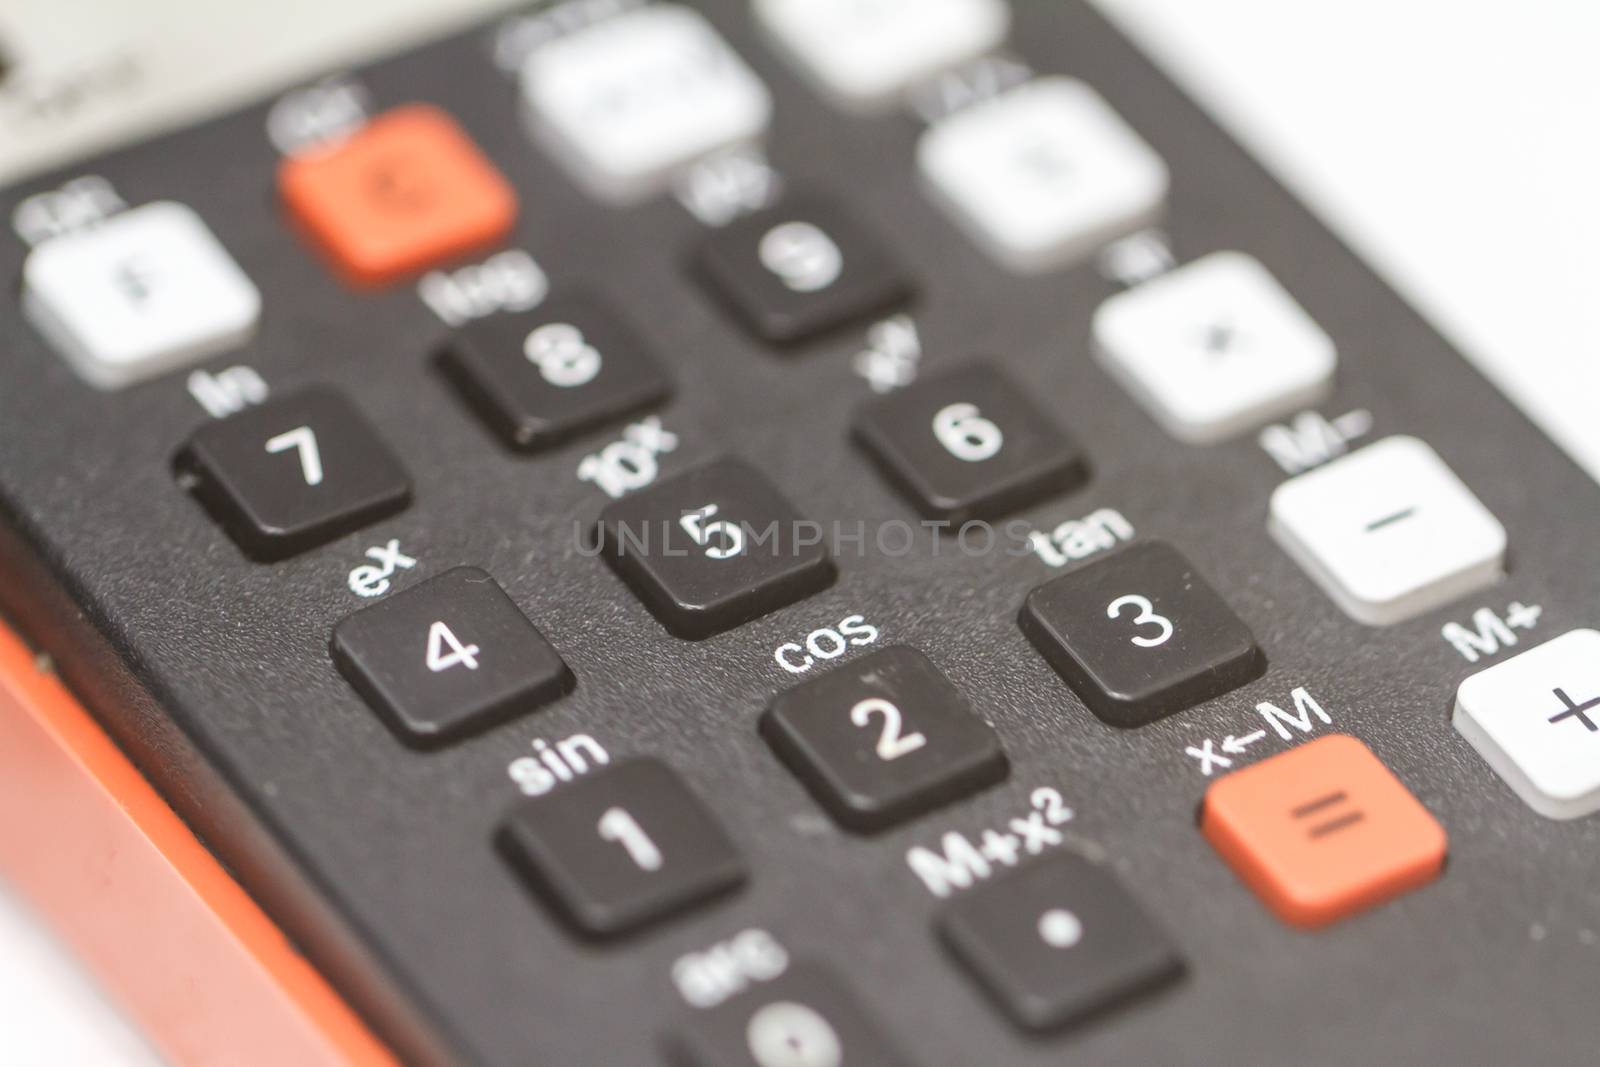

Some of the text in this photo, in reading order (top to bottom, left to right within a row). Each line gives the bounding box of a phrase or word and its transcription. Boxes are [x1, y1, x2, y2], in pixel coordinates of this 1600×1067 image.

[523, 322, 602, 388] 8
[264, 425, 324, 487] 7
[931, 402, 1004, 463] 6
[679, 503, 744, 560] 5
[1029, 508, 1134, 567] tan
[424, 619, 481, 673] 4
[772, 614, 879, 674] cos
[1108, 593, 1174, 649] 3
[1440, 601, 1544, 663] M+
[849, 697, 926, 761] 2
[507, 732, 610, 797] sin
[596, 806, 663, 871] 1
